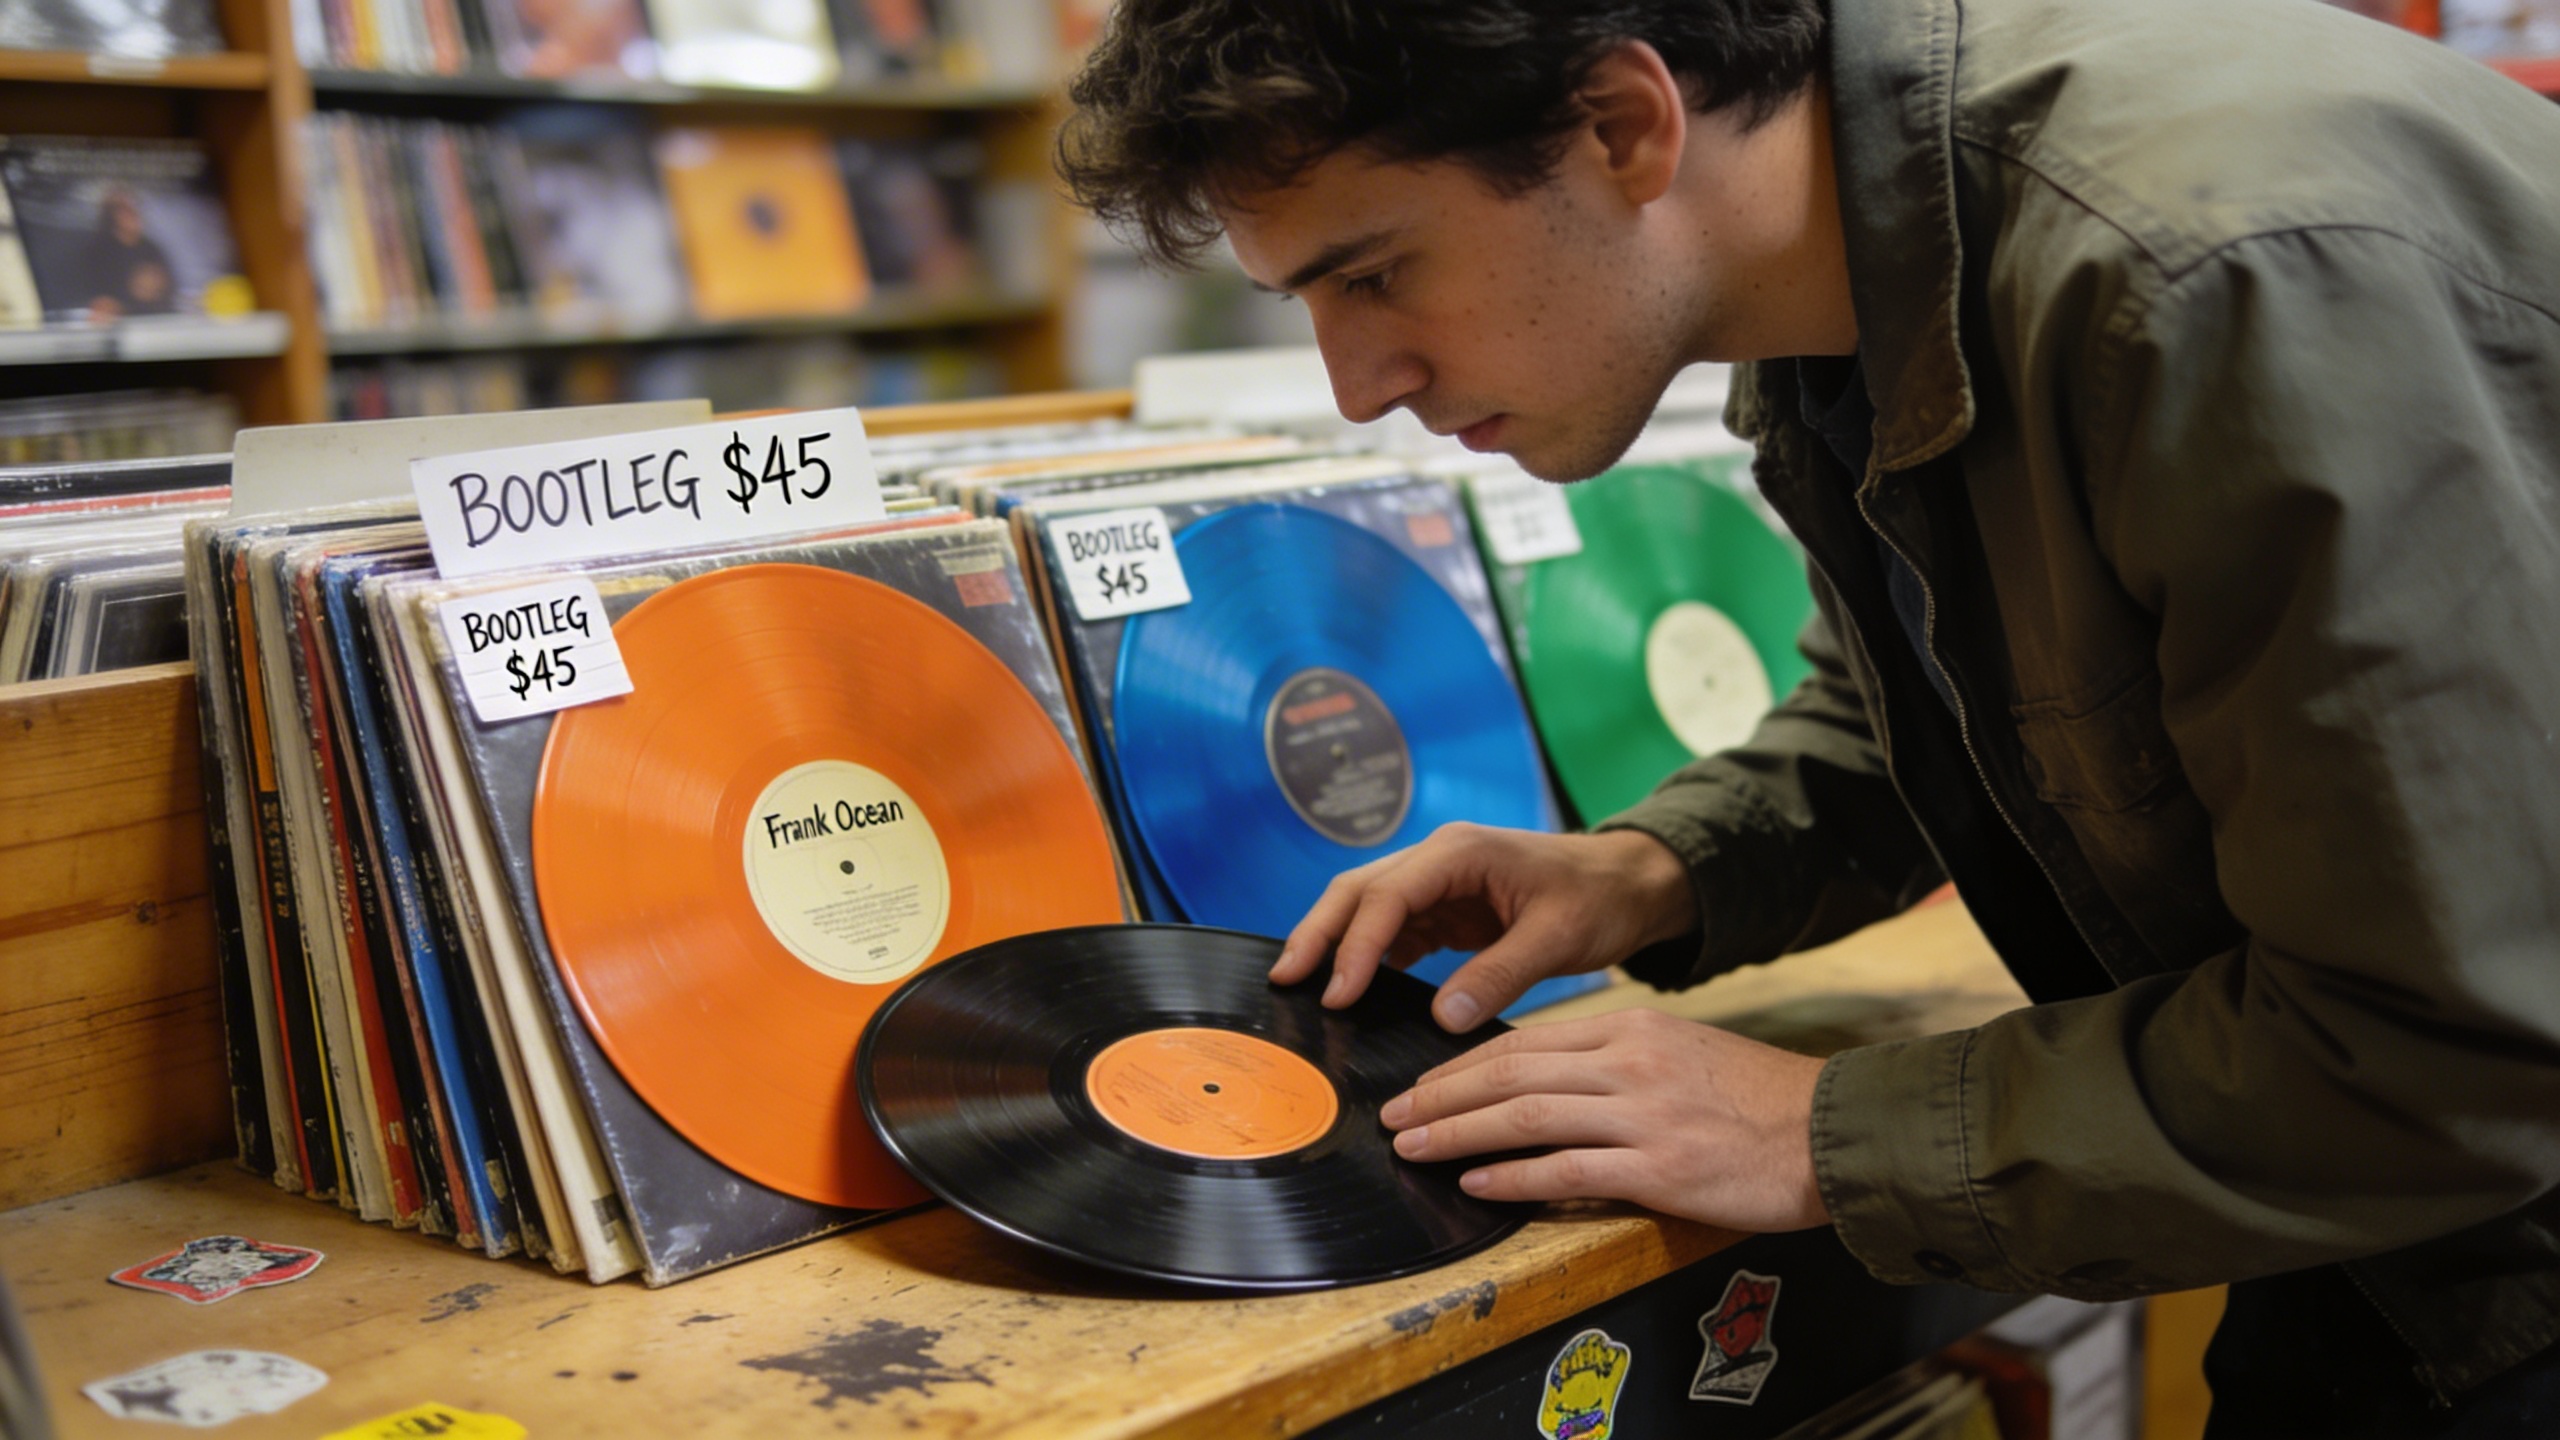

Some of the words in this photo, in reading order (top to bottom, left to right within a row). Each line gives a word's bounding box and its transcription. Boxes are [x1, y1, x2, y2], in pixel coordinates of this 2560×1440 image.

[449, 449, 701, 548] BOOTLEG
[723, 431, 831, 514] $45
[1067, 521, 1160, 562] BOOTLEG
[1097, 561, 1148, 602] $45
[461, 595, 590, 653] BOOTLEG
[506, 646, 577, 701] $45
[763, 804, 832, 849] Frank
[835, 799, 904, 831] Ocean
